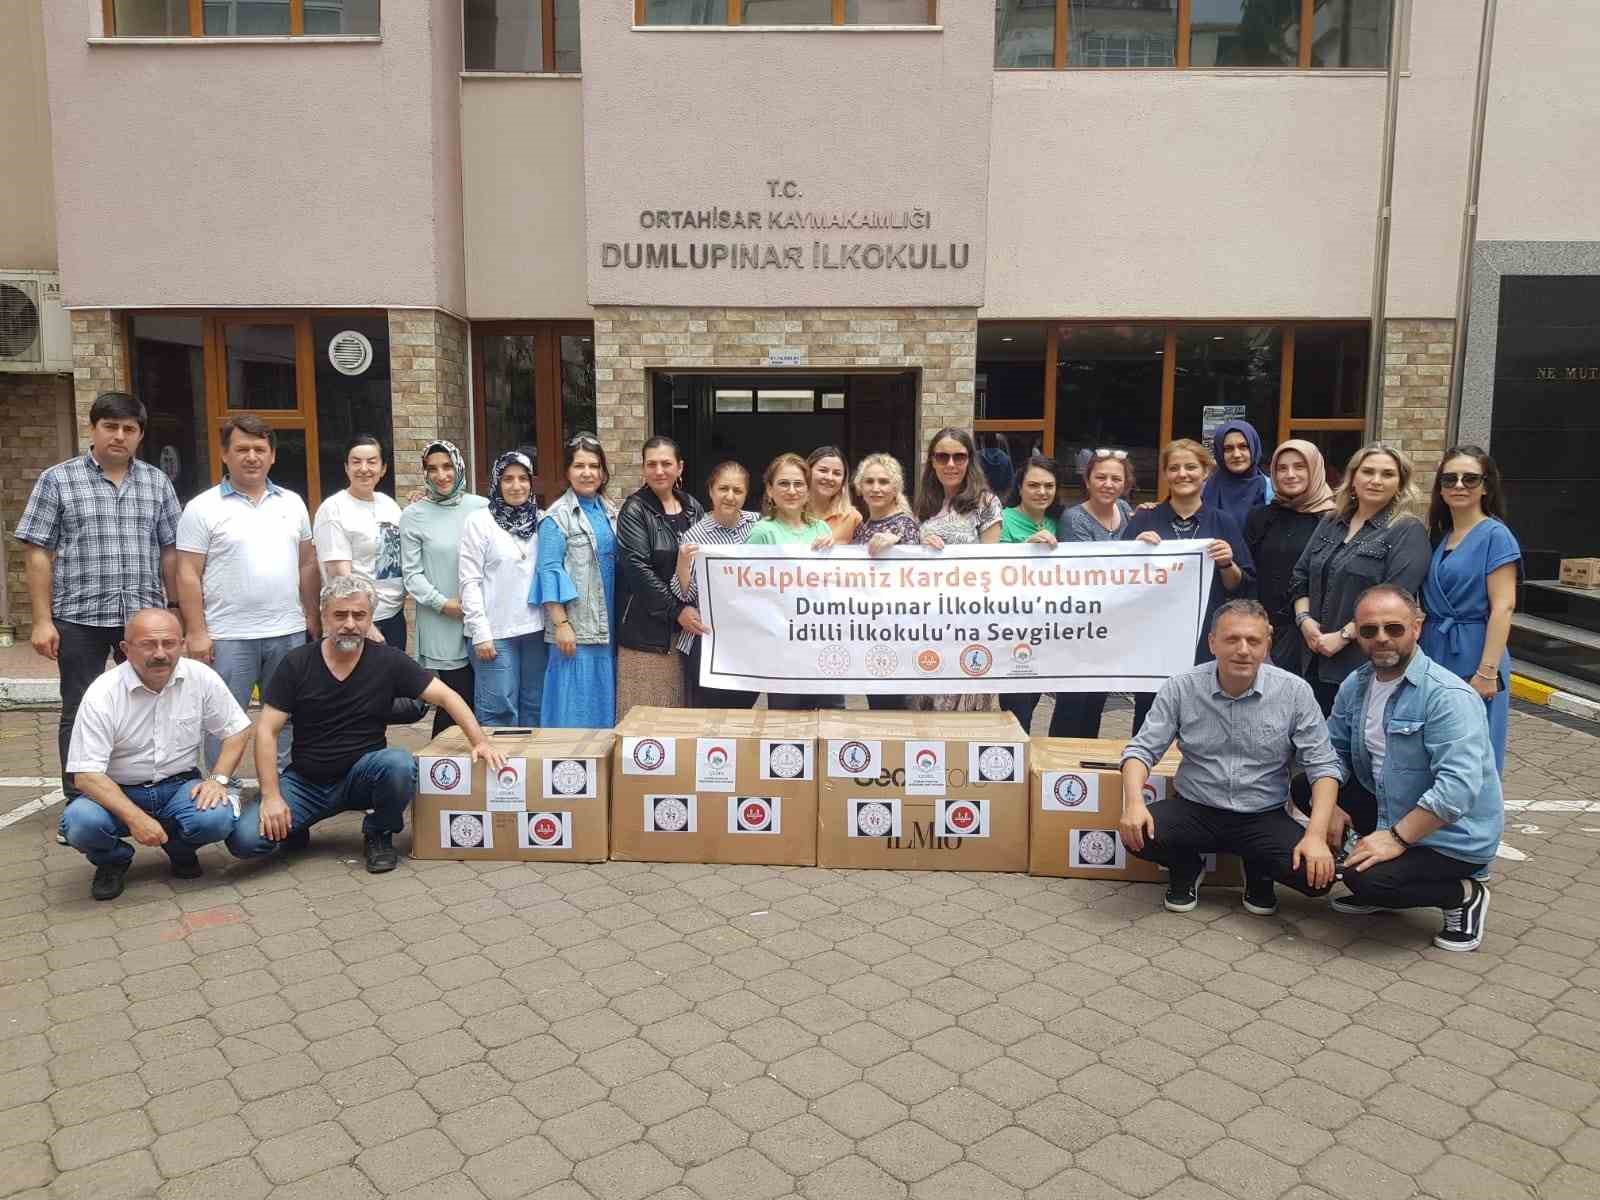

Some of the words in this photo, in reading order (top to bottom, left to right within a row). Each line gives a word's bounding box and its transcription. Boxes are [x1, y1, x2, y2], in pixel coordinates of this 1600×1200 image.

[766, 180, 803, 199] T.C.
[639, 206, 762, 230] ORTAHİSAR
[767, 207, 931, 230] KAYMAKAMLIĞI
[601, 242, 804, 269] DUMLUPINAR
[812, 240, 970, 269] İLKOKULU
[722, 566, 891, 594] “Kalplerimiz
[900, 565, 992, 593] Kardeş
[796, 596, 932, 620] Dumlupınar
[938, 593, 1102, 616] İlkokulu’ndan
[788, 619, 842, 641] İdilli
[849, 619, 980, 642] İlkokulu’na
[987, 621, 1108, 646] Sevgilerle
